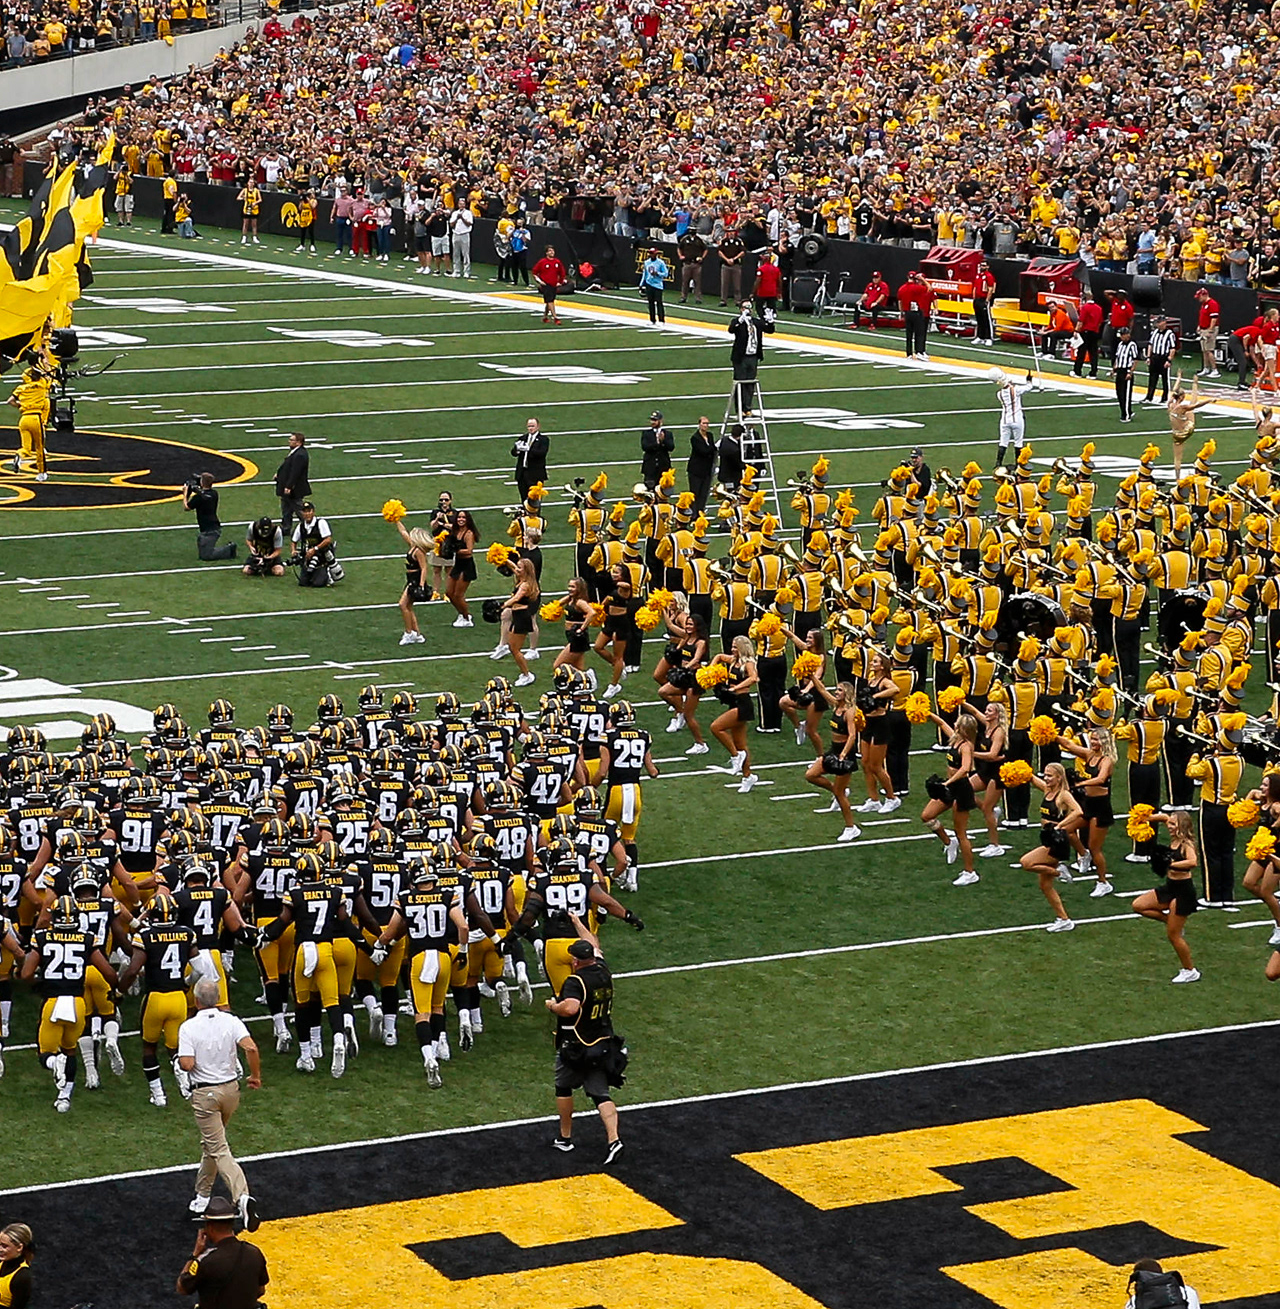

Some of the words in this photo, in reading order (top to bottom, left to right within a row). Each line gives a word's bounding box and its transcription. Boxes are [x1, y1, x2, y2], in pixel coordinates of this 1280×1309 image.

[931, 282, 958, 291] GATORADE
[572, 714, 604, 742] 79
[614, 740, 645, 768] 29
[295, 790, 319, 816] 41
[530, 774, 561, 804] 42
[380, 791, 397, 822] 6
[121, 820, 152, 852] 91
[211, 815, 241, 847] 17
[336, 821, 369, 853] 25
[496, 827, 527, 860] 48
[256, 868, 297, 899] 40
[371, 873, 401, 907] 51
[546, 883, 587, 917] 99
[194, 901, 214, 935] 4
[308, 901, 329, 935] 7
[405, 904, 447, 939] 30
[53, 932, 85, 943] WILLIAMS
[157, 932, 188, 942] WILLIAMS
[44, 943, 85, 979] 25
[161, 944, 181, 979] 4
